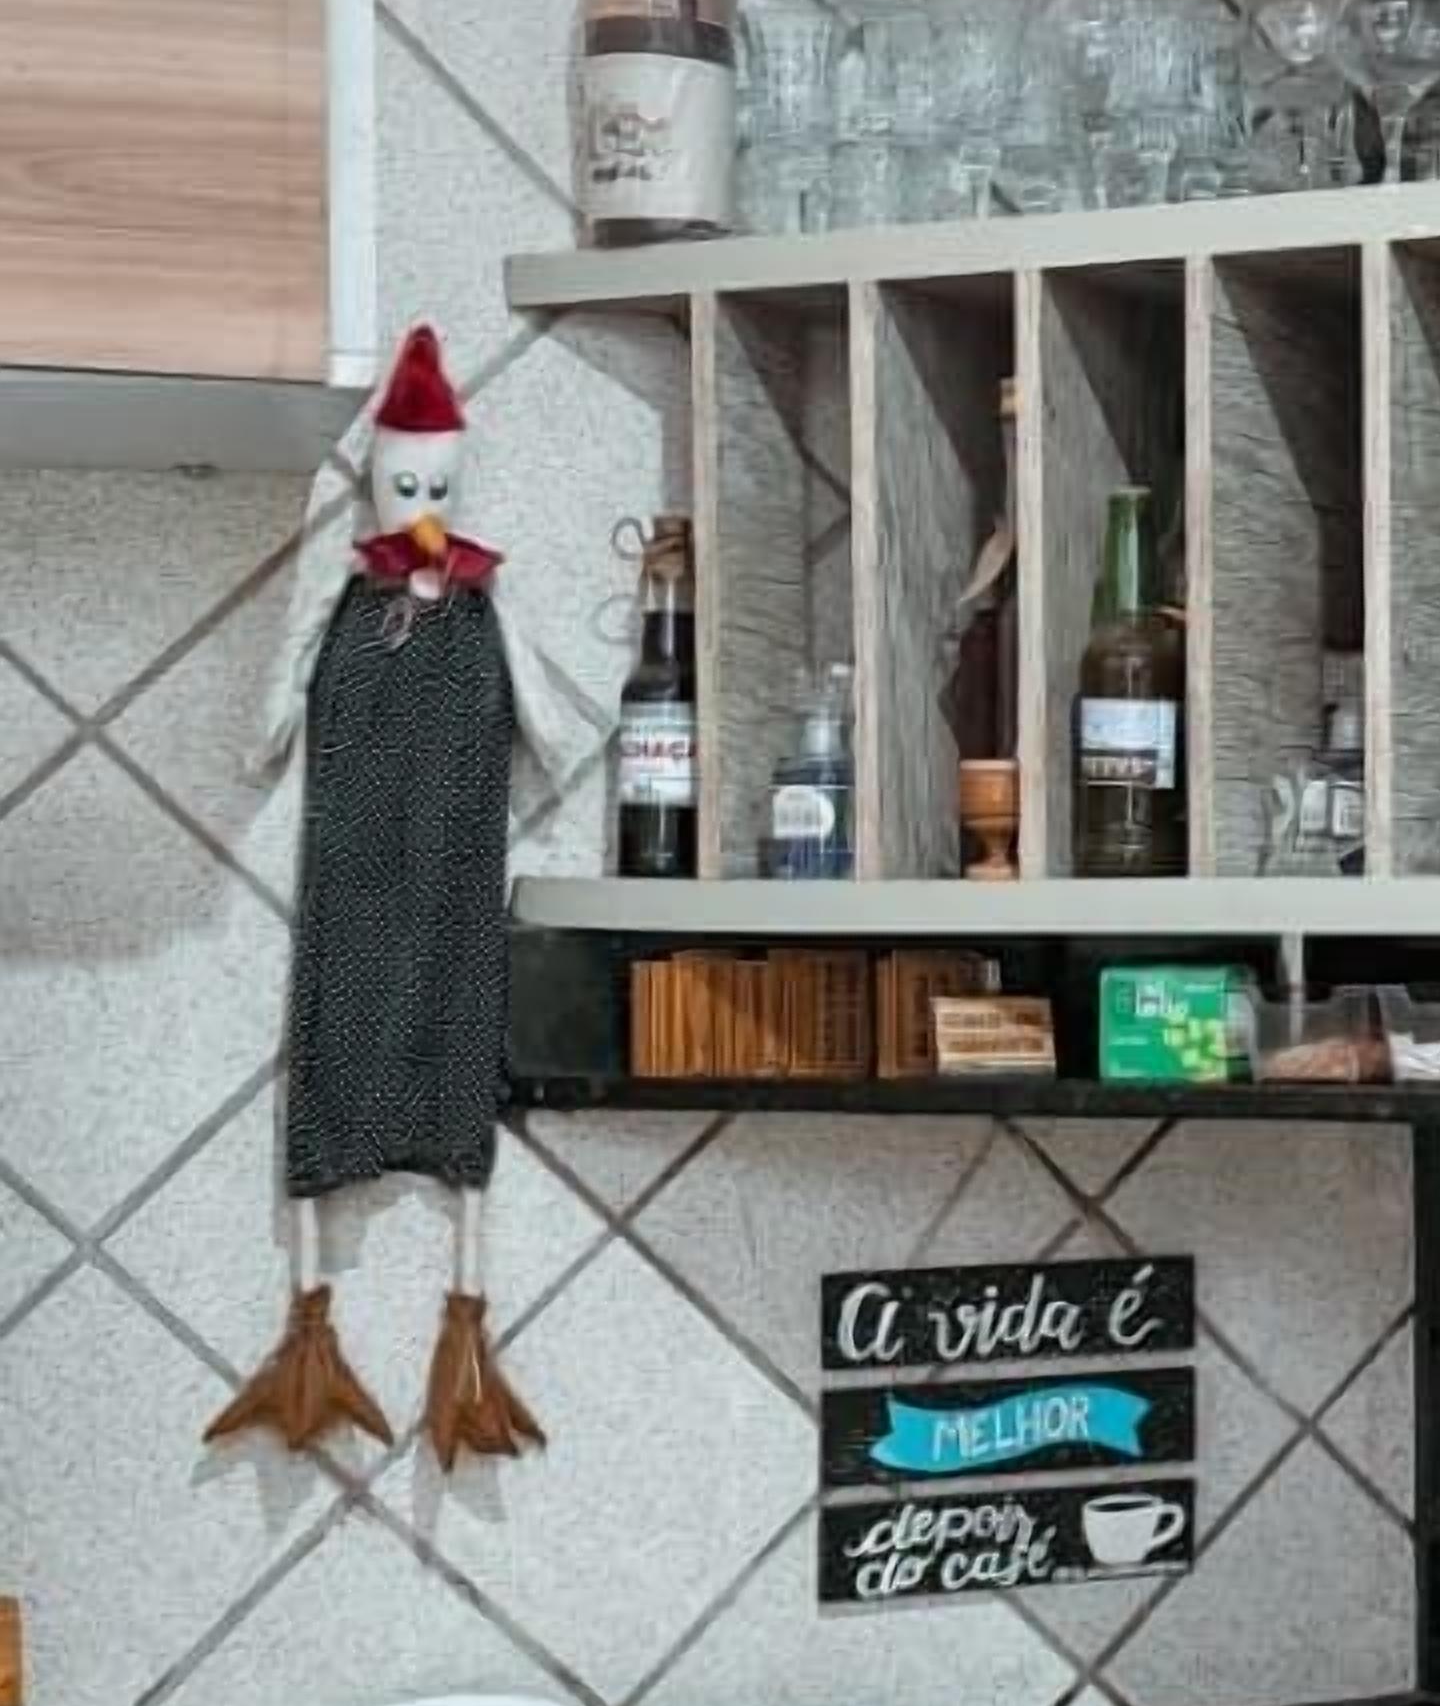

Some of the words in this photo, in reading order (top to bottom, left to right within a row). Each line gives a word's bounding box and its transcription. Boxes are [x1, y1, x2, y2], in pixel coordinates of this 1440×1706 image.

[926, 1273, 1086, 1360] vida
[1107, 1264, 1165, 1345] é
[933, 1396, 1090, 1461] MELHOR
